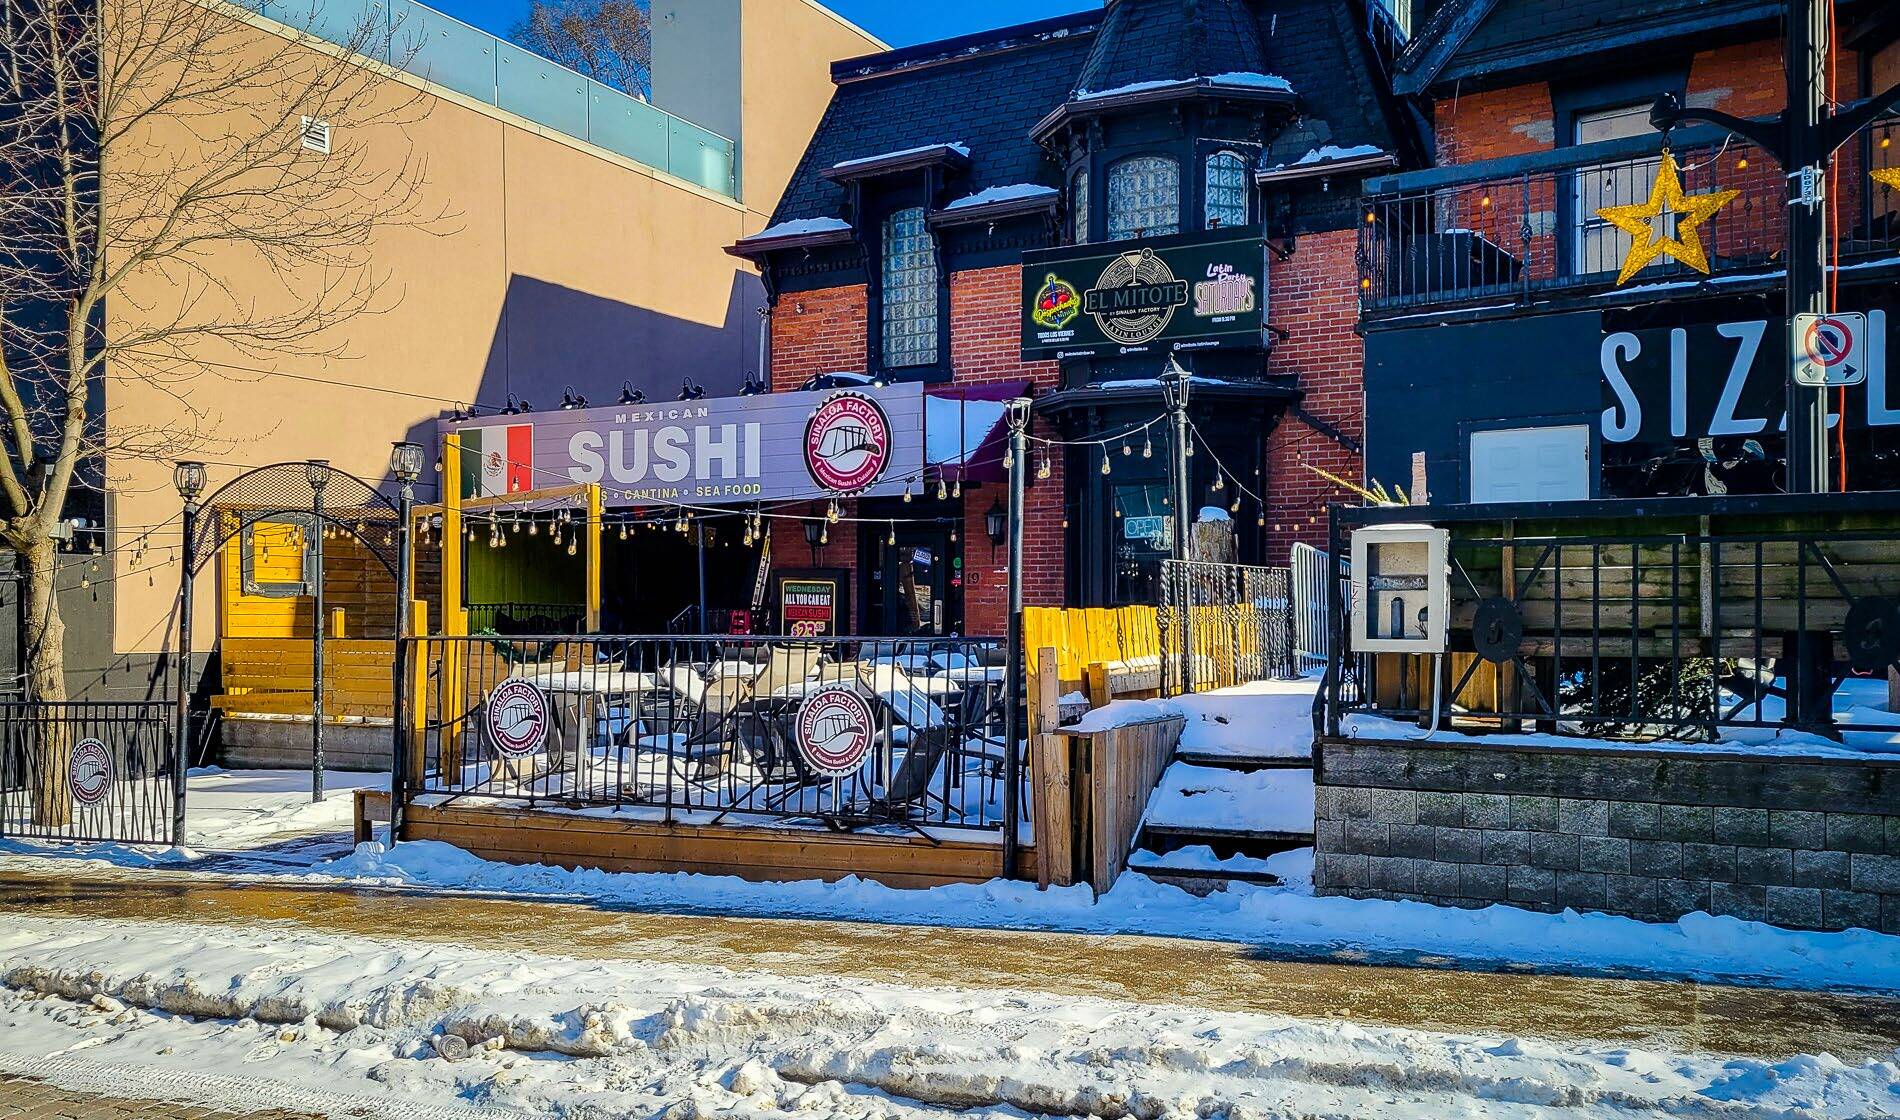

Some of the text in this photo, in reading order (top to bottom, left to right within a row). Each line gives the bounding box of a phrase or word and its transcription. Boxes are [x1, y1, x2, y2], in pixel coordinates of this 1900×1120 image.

[1206, 263, 1233, 278] Latin
[1088, 284, 1185, 310] EL MITOTE
[1105, 321, 1128, 338] LATIN
[1601, 310, 1900, 443] SIZL
[615, 407, 709, 424] MEXICAN
[811, 401, 883, 445] SINALOA FACTORY
[568, 423, 761, 484] SUSHI
[819, 467, 837, 485] Mexican
[857, 466, 874, 483] Cuisine
[624, 487, 679, 501] CANTINA
[696, 485, 720, 497] SEA
[724, 483, 761, 496] FOOD
[1126, 518, 1161, 535] OPEN
[967, 572, 979, 584] 19
[785, 585, 831, 593] WEDNESDAY
[785, 594, 831, 606] ALL YOU CAN EAT
[808, 608, 829, 618] SUSHI
[493, 686, 541, 722] SINALOA FACTORY
[805, 694, 865, 735] SINALOA FACTORY
